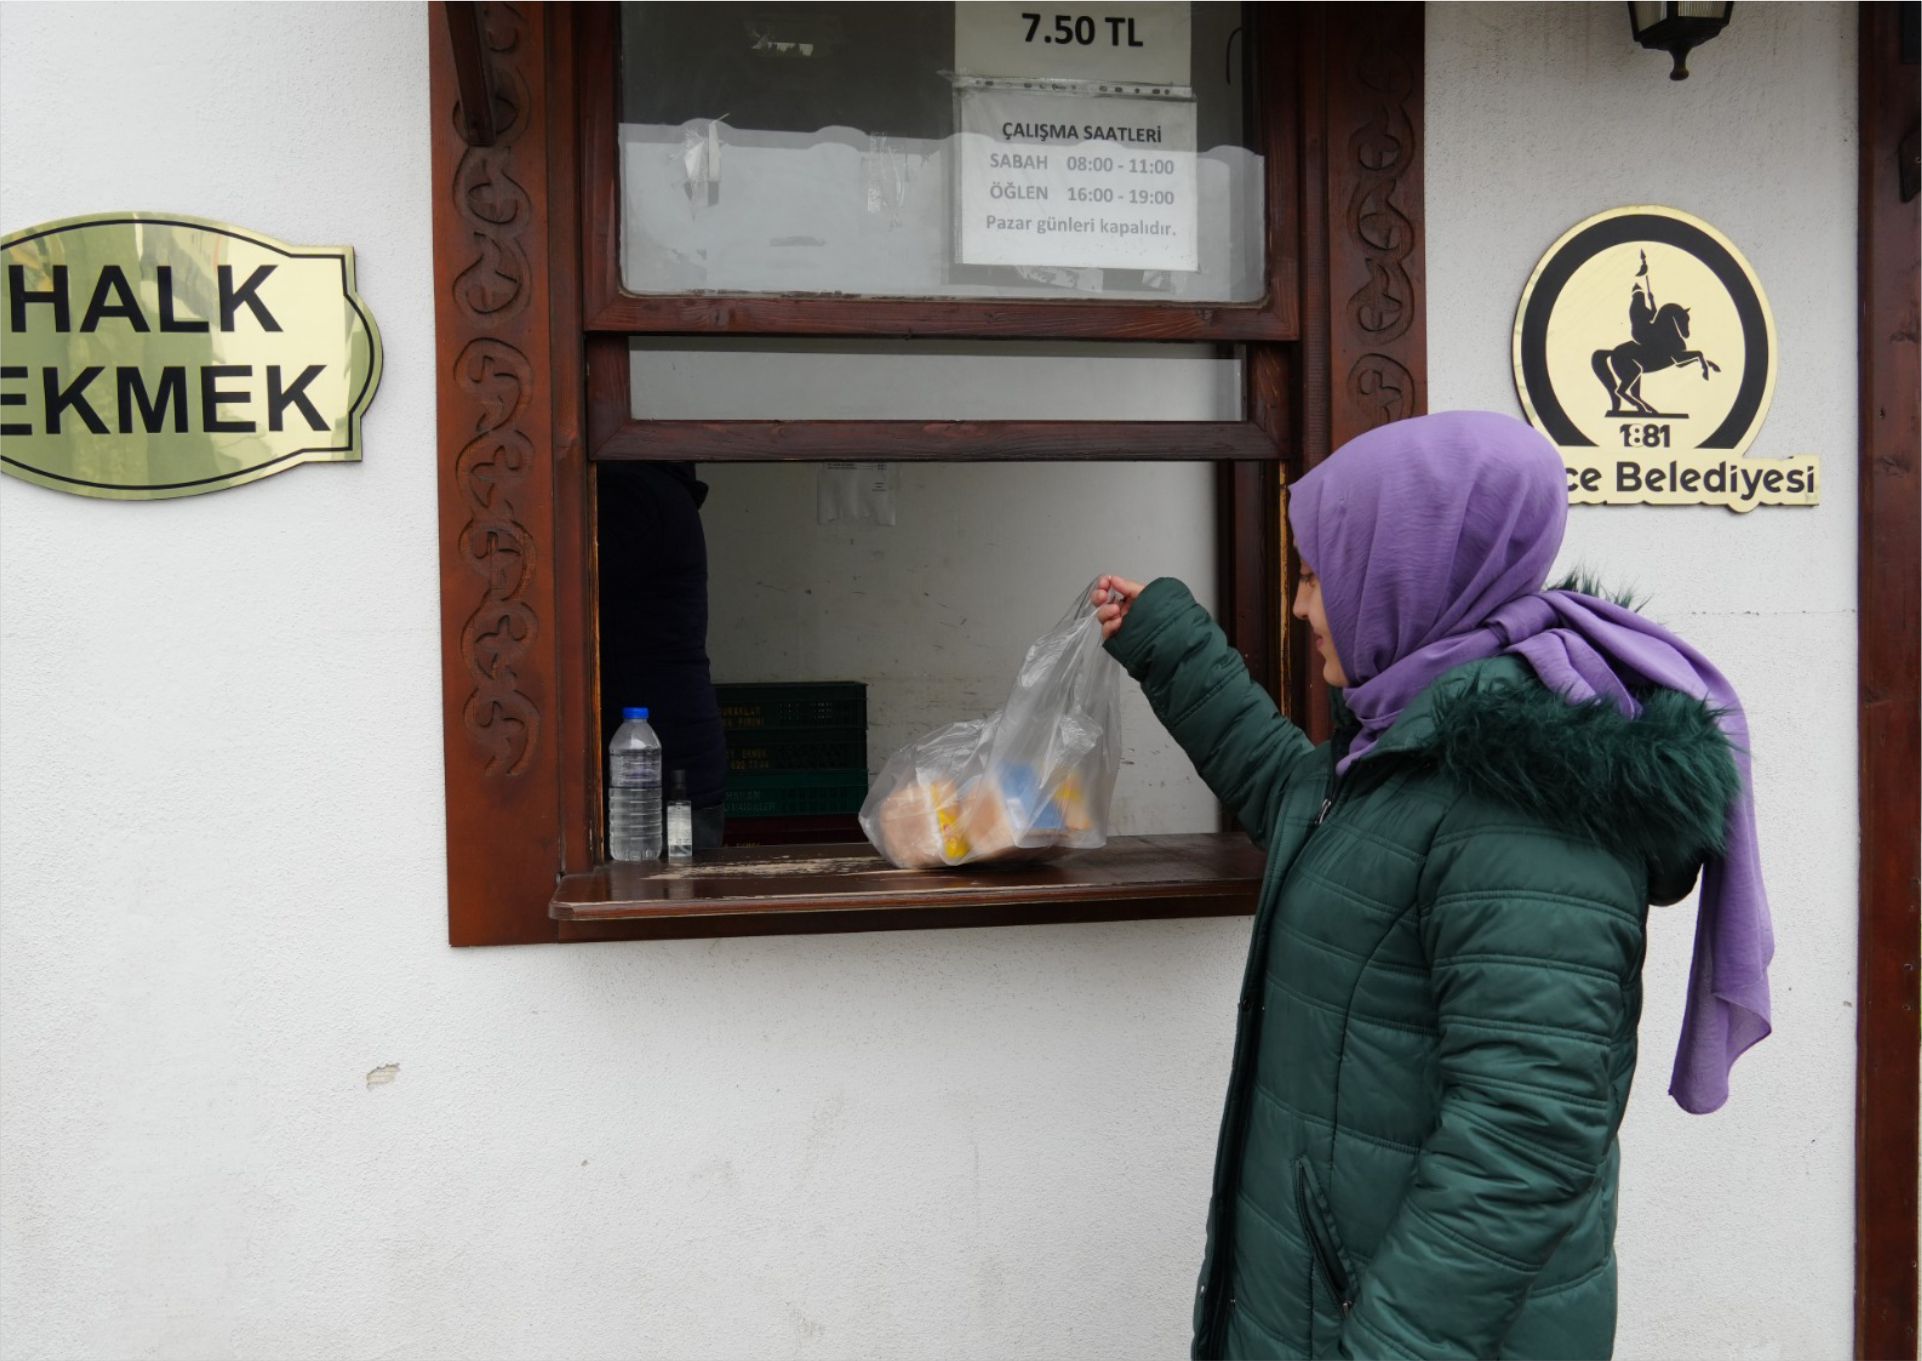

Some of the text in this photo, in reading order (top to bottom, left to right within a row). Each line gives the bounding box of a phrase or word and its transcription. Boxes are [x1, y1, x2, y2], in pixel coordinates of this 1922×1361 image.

[1021, 12, 1144, 47] 7.50 TL
[1002, 122, 1162, 143] ÇALIŞMA SAATLERİ
[990, 153, 1048, 170] SABAH
[1066, 156, 1114, 173] 08:00
[1128, 158, 1175, 175] 11:00
[989, 181, 1049, 201] ÖĞLEN
[1067, 187, 1114, 204] 16:00
[1128, 189, 1175, 206] 19:00
[986, 215, 1177, 238] Pazar günleri kapalıdır.
[8, 264, 284, 333] HALK
[0, 364, 331, 436] EKMEK
[1619, 423, 1671, 448] 1881
[1616, 461, 1815, 501] Belediyesi
